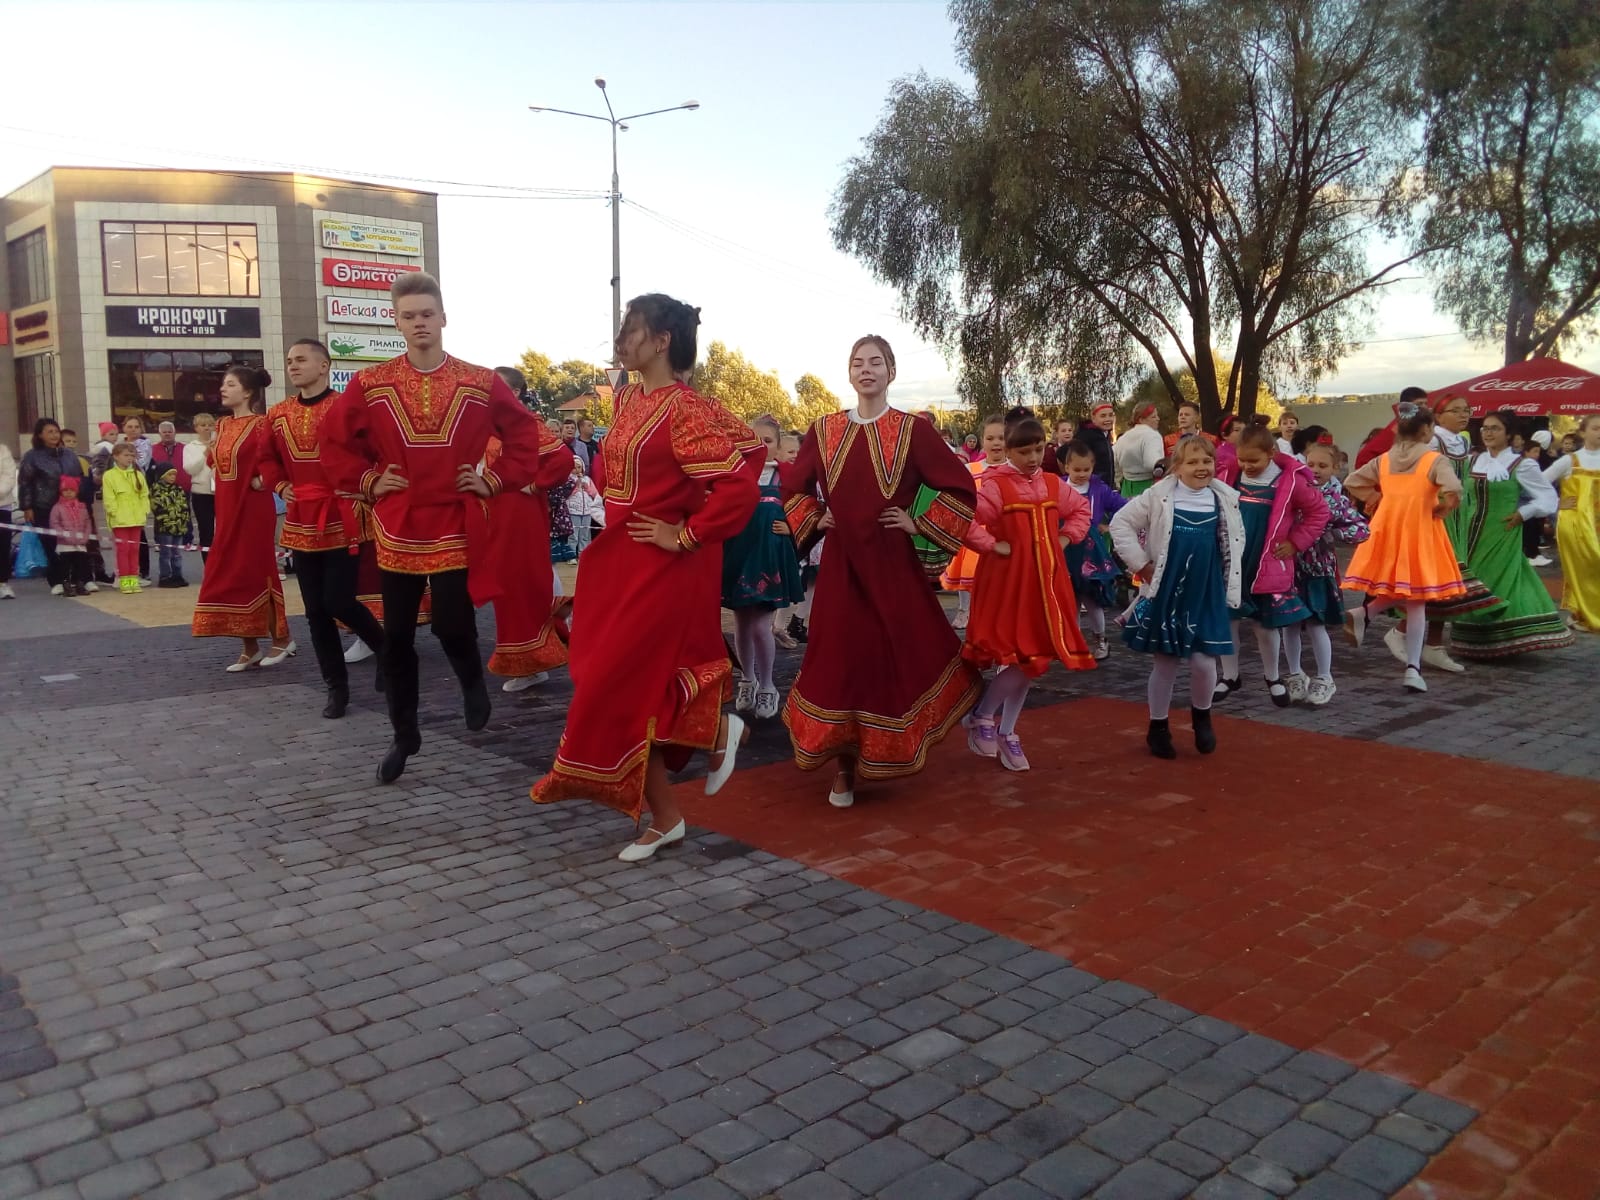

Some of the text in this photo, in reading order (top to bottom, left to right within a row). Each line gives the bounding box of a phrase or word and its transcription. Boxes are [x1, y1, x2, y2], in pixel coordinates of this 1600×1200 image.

[332, 263, 398, 283] Бристо
[137, 307, 228, 326] КРОКОФИТ
[332, 299, 377, 318] Детская
[152, 326, 216, 335] ФИТНЕС-КЛУБ
[369, 339, 406, 348] ЛИМПО
[1469, 376, 1592, 392] Coca-Cola
[1498, 403, 1541, 412] Coca-Cola
